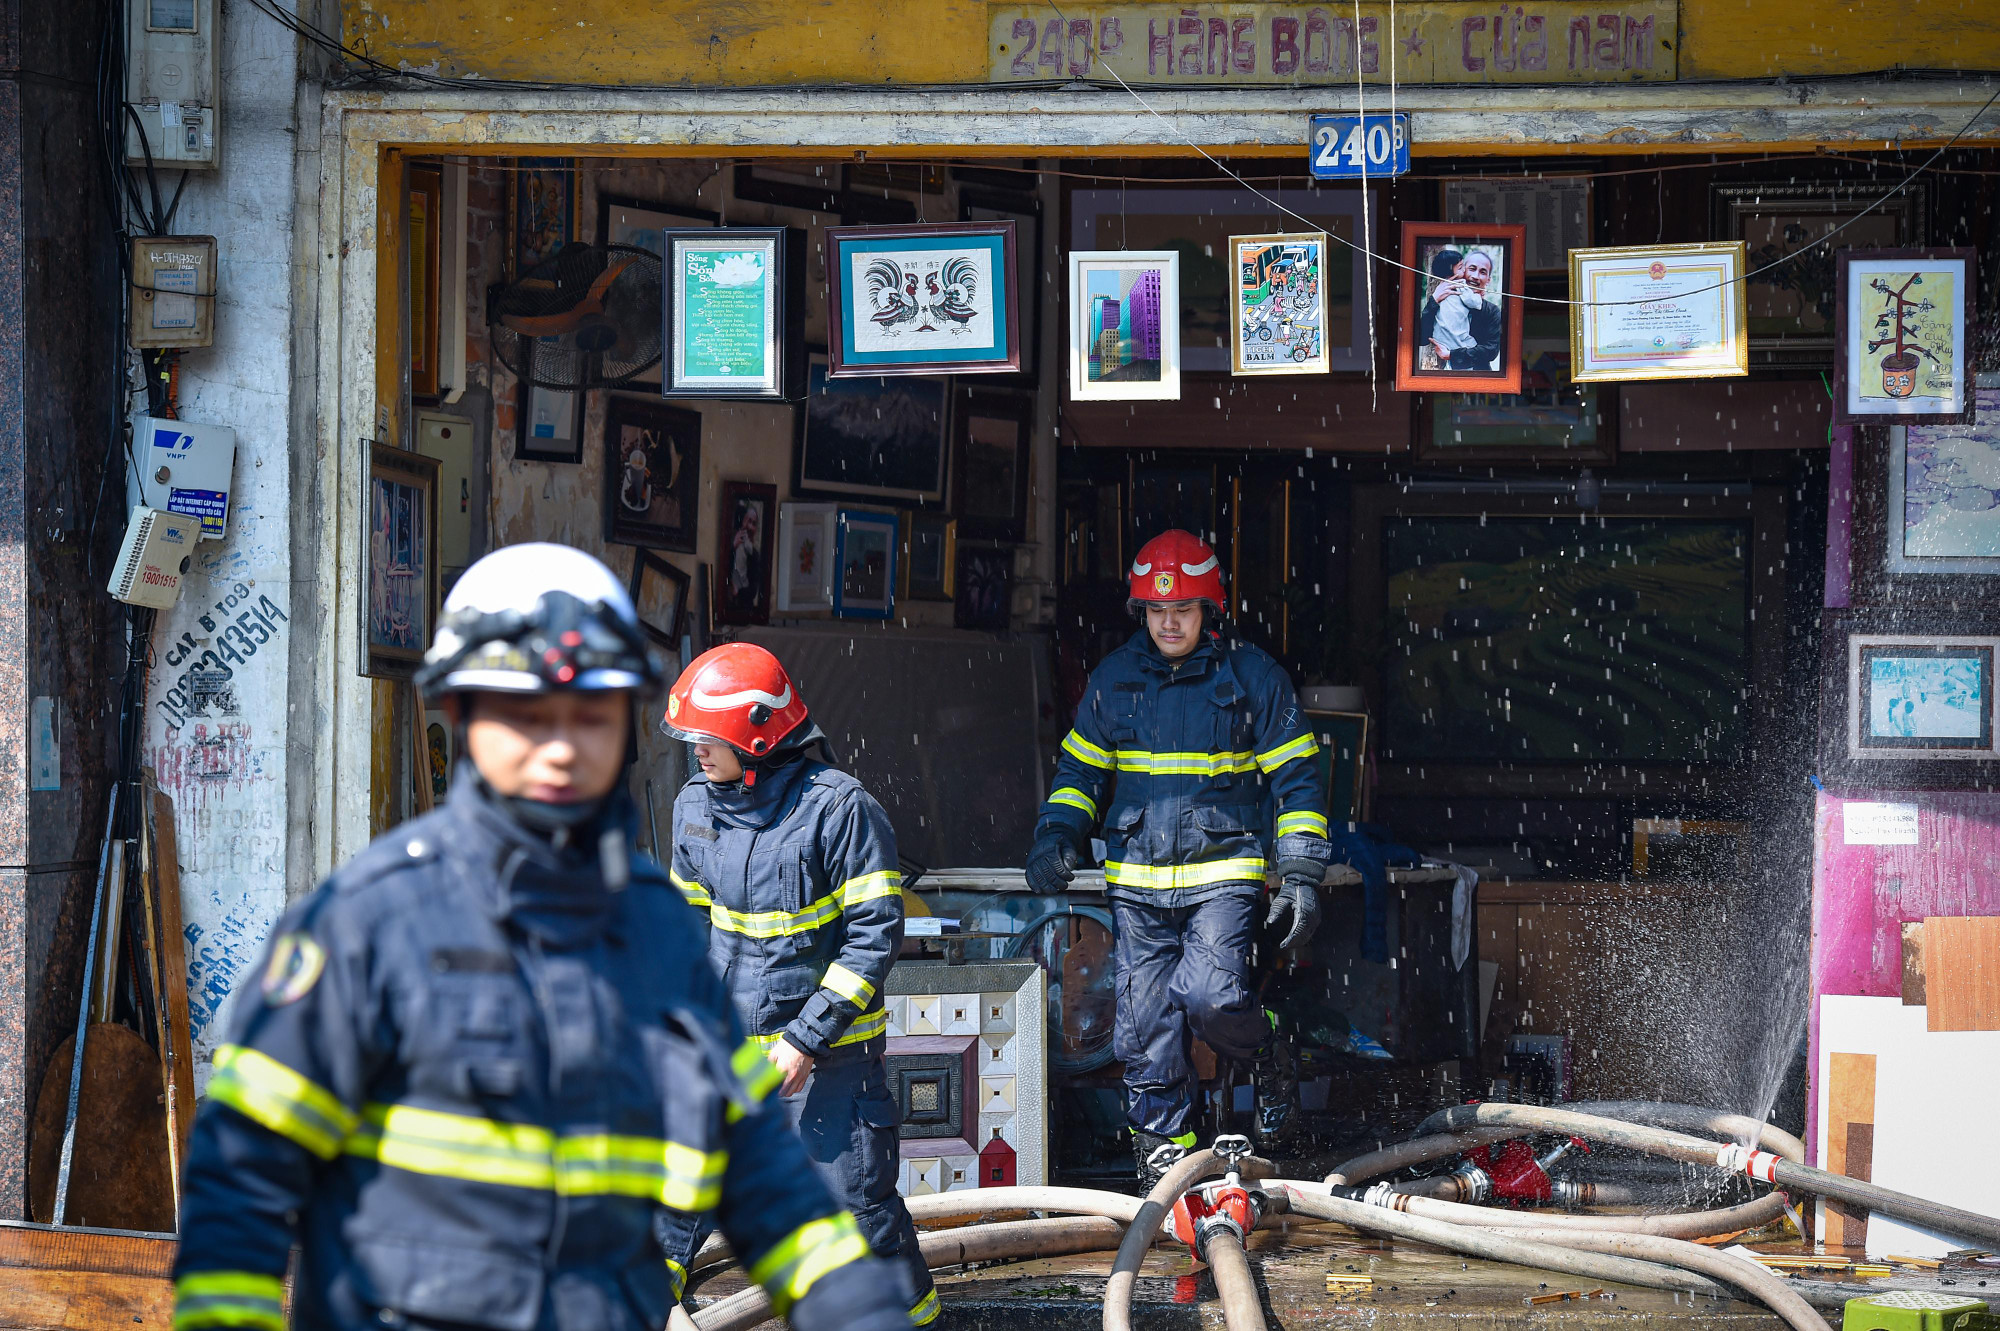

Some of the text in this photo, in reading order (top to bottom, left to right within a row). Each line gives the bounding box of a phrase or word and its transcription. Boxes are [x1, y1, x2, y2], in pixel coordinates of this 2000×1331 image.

[687, 252, 708, 262] Sống
[1246, 353, 1275, 361] BALM
[167, 452, 187, 460] VNPT
[142, 570, 178, 588] 19001515
